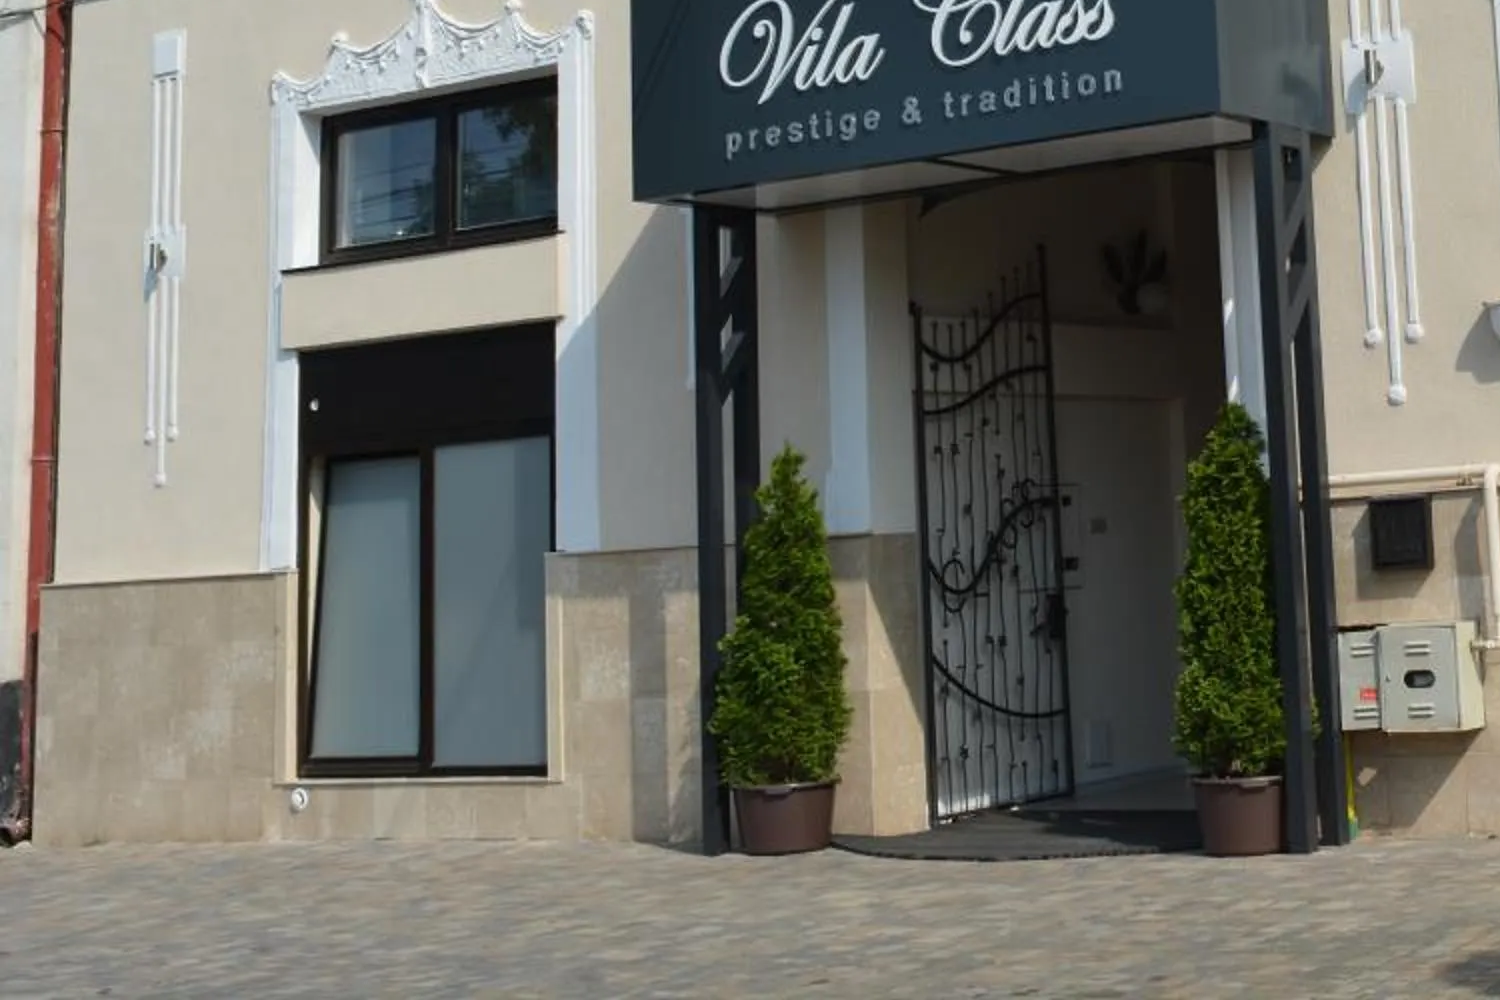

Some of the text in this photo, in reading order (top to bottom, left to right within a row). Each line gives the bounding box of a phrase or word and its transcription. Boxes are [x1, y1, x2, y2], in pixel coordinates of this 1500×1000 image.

[726, 67, 1123, 159] prestige & tradition
